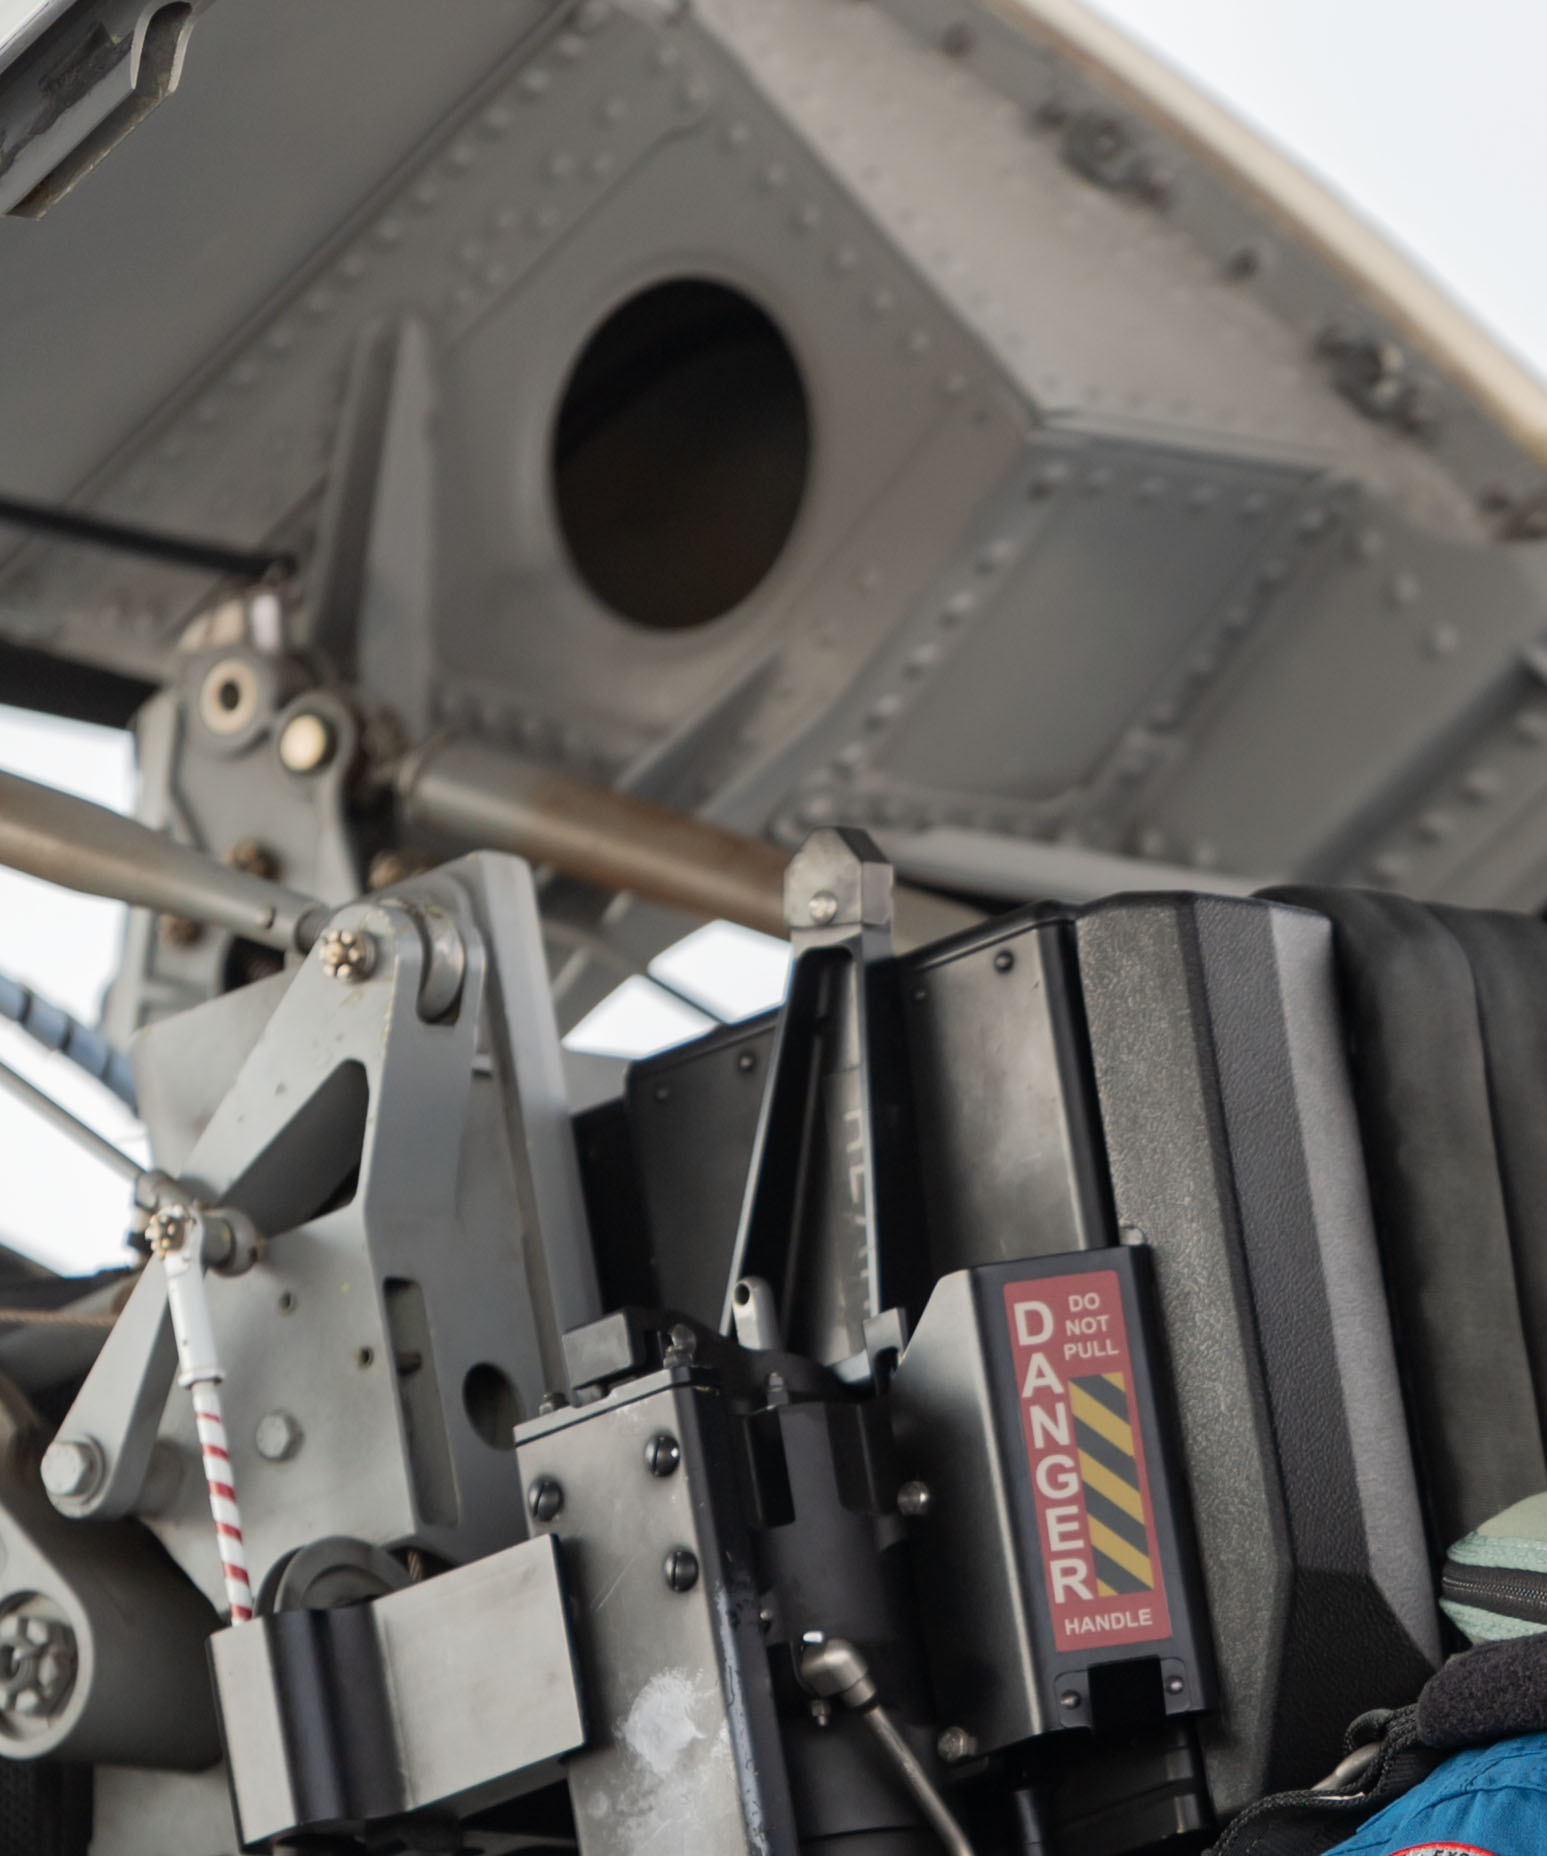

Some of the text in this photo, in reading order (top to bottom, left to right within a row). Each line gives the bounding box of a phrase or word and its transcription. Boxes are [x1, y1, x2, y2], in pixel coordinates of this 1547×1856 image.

[1067, 1291, 1101, 1313] DO
[1064, 1314, 1110, 1337] NOT
[1063, 1337, 1120, 1361] PULL
[1012, 1299, 1094, 1604] DANGER
[1064, 1607, 1153, 1636] HANDLE
